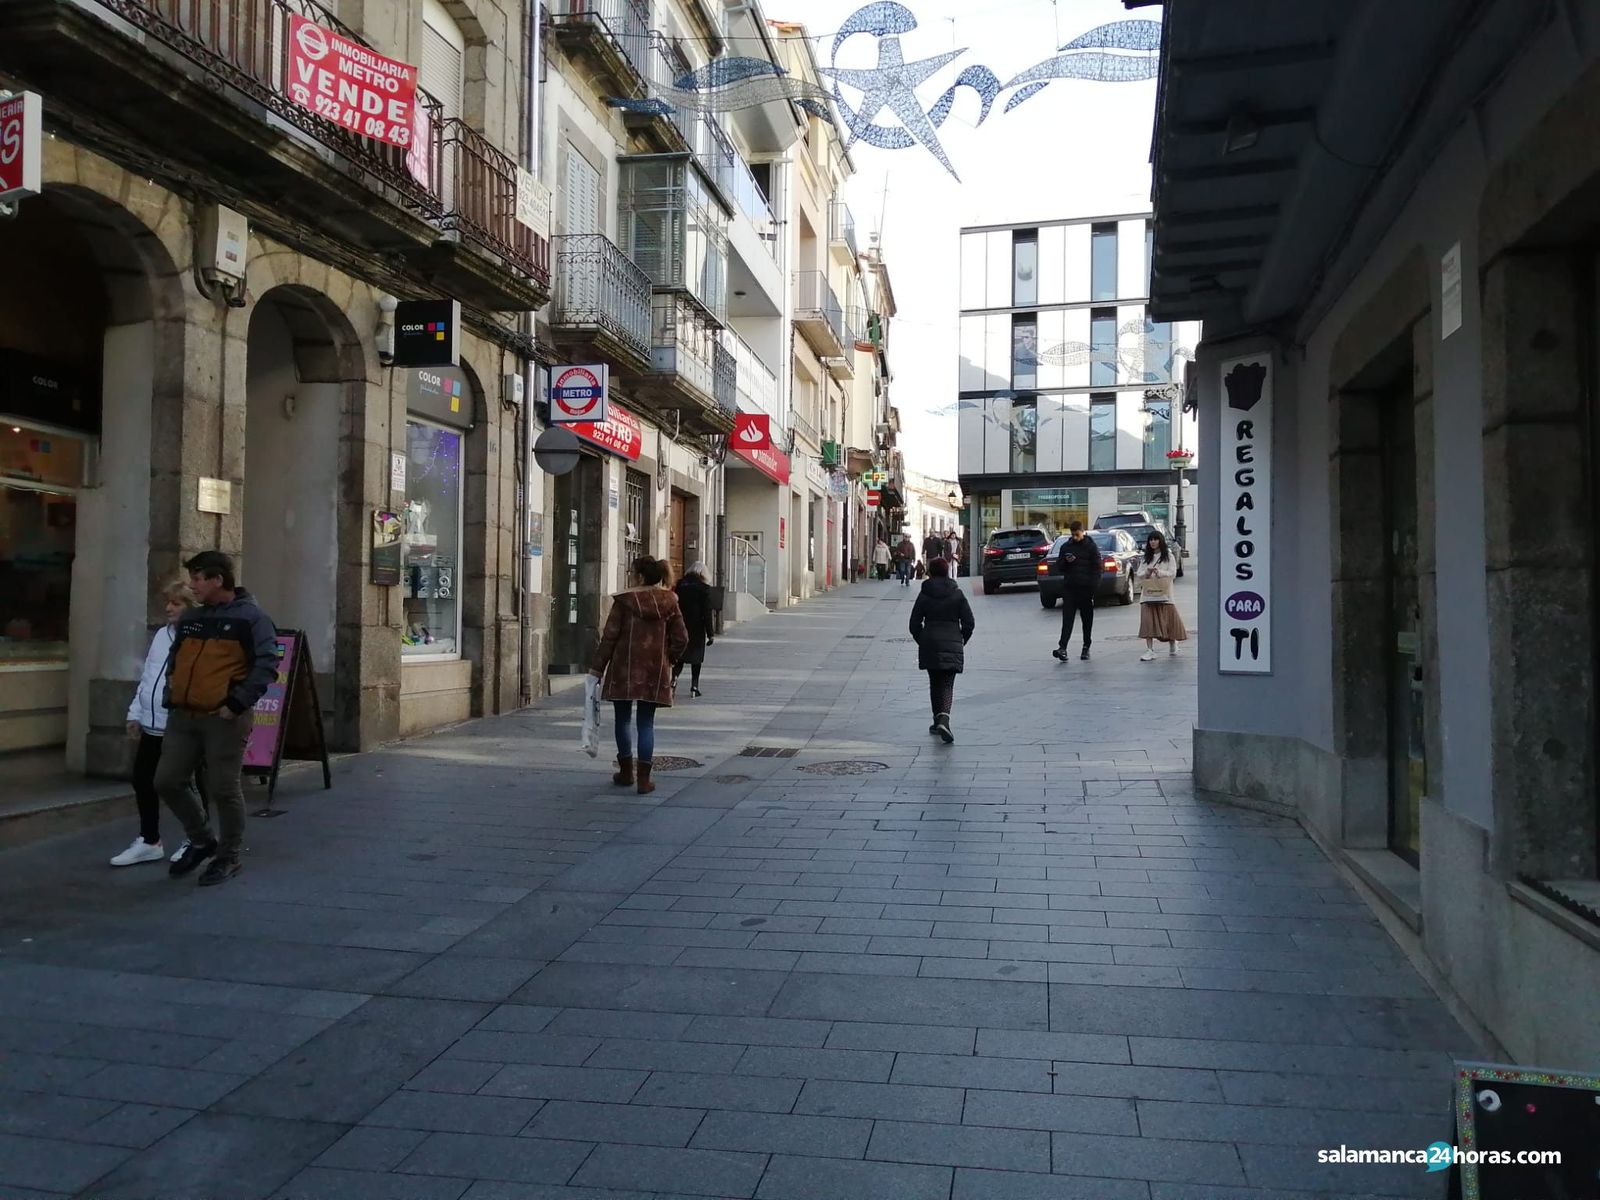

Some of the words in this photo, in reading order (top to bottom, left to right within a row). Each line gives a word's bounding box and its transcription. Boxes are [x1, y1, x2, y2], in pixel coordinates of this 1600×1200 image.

[331, 37, 410, 80] INMOBILIARIA
[339, 57, 399, 93] METRO
[296, 56, 409, 124] VENDE
[315, 94, 340, 120] 923
[343, 108, 361, 130] 41
[365, 117, 385, 138] 08
[388, 125, 410, 146] 43
[418, 370, 441, 387] COLOR
[562, 389, 593, 398] METRO
[592, 430, 605, 441] 923
[605, 436, 613, 445] 41
[1234, 420, 1255, 581] REGALOS
[1228, 599, 1261, 613] PARA
[1230, 627, 1259, 660] TI
